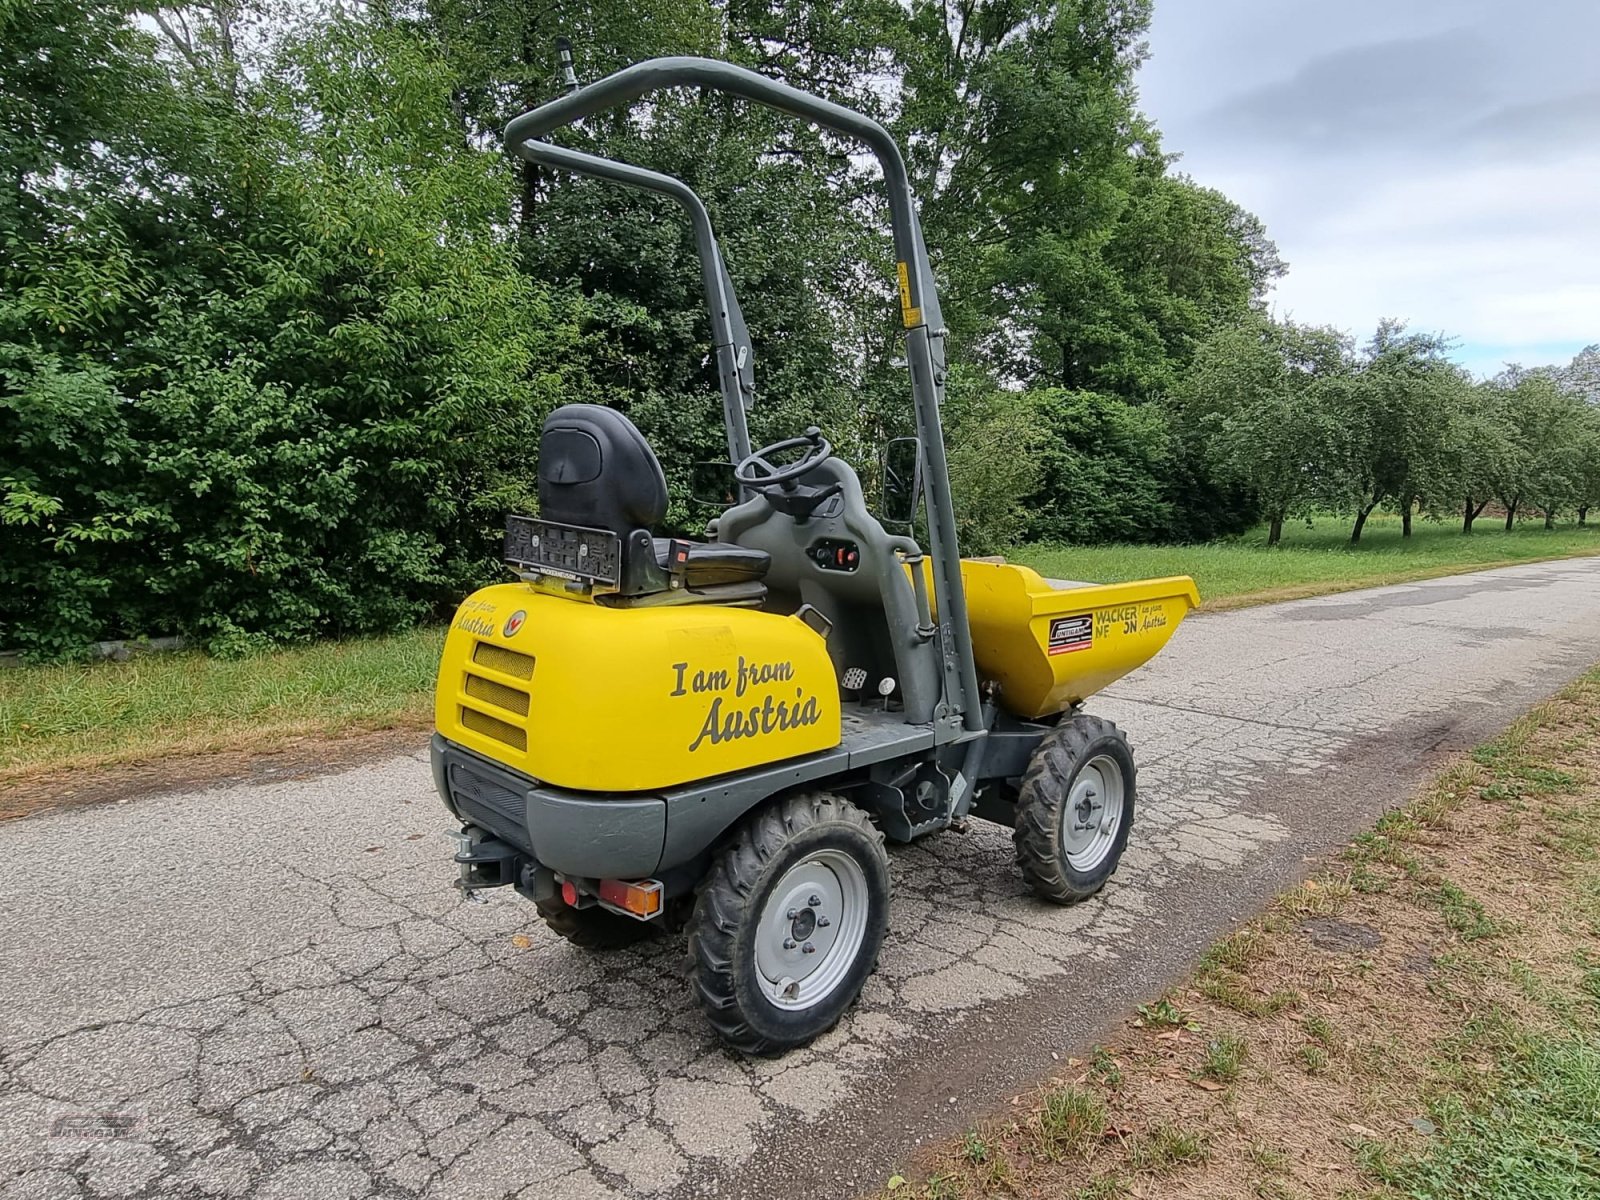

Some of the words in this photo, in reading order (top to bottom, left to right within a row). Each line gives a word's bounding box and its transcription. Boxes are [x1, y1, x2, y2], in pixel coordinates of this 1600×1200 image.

[453, 610, 495, 637] Austria
[1095, 606, 1137, 625] WACKER
[1140, 613, 1167, 632] Austria
[670, 662, 688, 697] I
[692, 669, 731, 693] am
[736, 656, 794, 698] from
[689, 687, 822, 752] Austria
